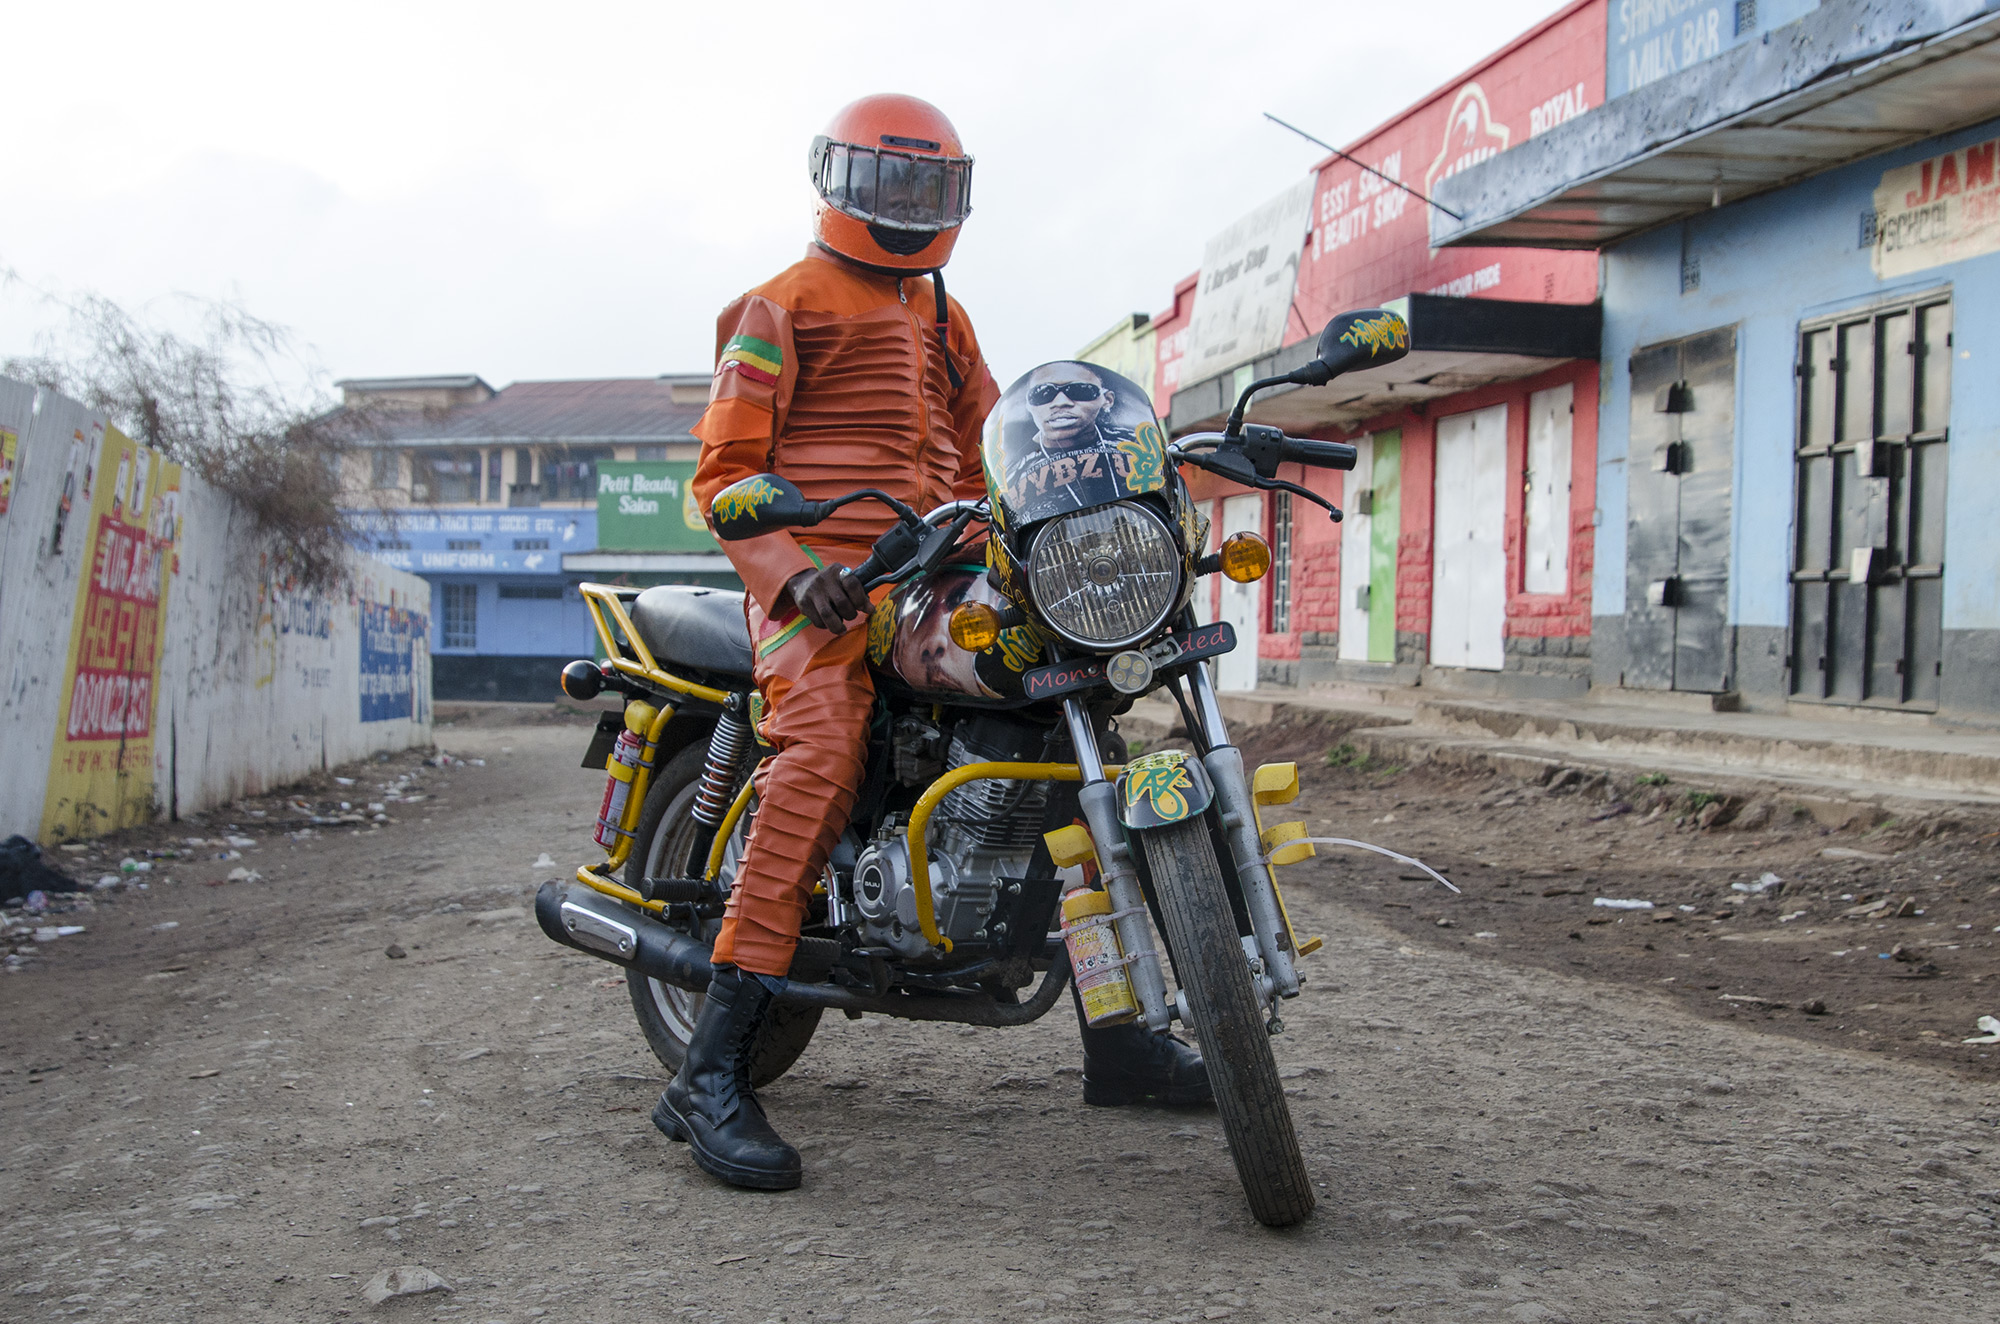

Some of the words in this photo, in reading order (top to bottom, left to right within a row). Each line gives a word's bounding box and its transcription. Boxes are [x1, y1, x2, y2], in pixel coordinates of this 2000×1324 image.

[1628, 27, 1678, 92] MILK
[1681, 7, 1720, 69] BAR
[1529, 81, 1589, 139] ROYAL
[1321, 177, 1352, 224] ESSY
[1358, 149, 1402, 203] SALON
[1905, 137, 2000, 209] JAN
[1323, 201, 1370, 255] BEAUTY
[1373, 180, 1409, 231] SHOP
[598, 473, 631, 494] Petit
[631, 473, 680, 500] Beauty
[618, 494, 659, 515] Salon
[499, 515, 530, 532] SOCKS
[421, 552, 495, 569] UNIFORM
